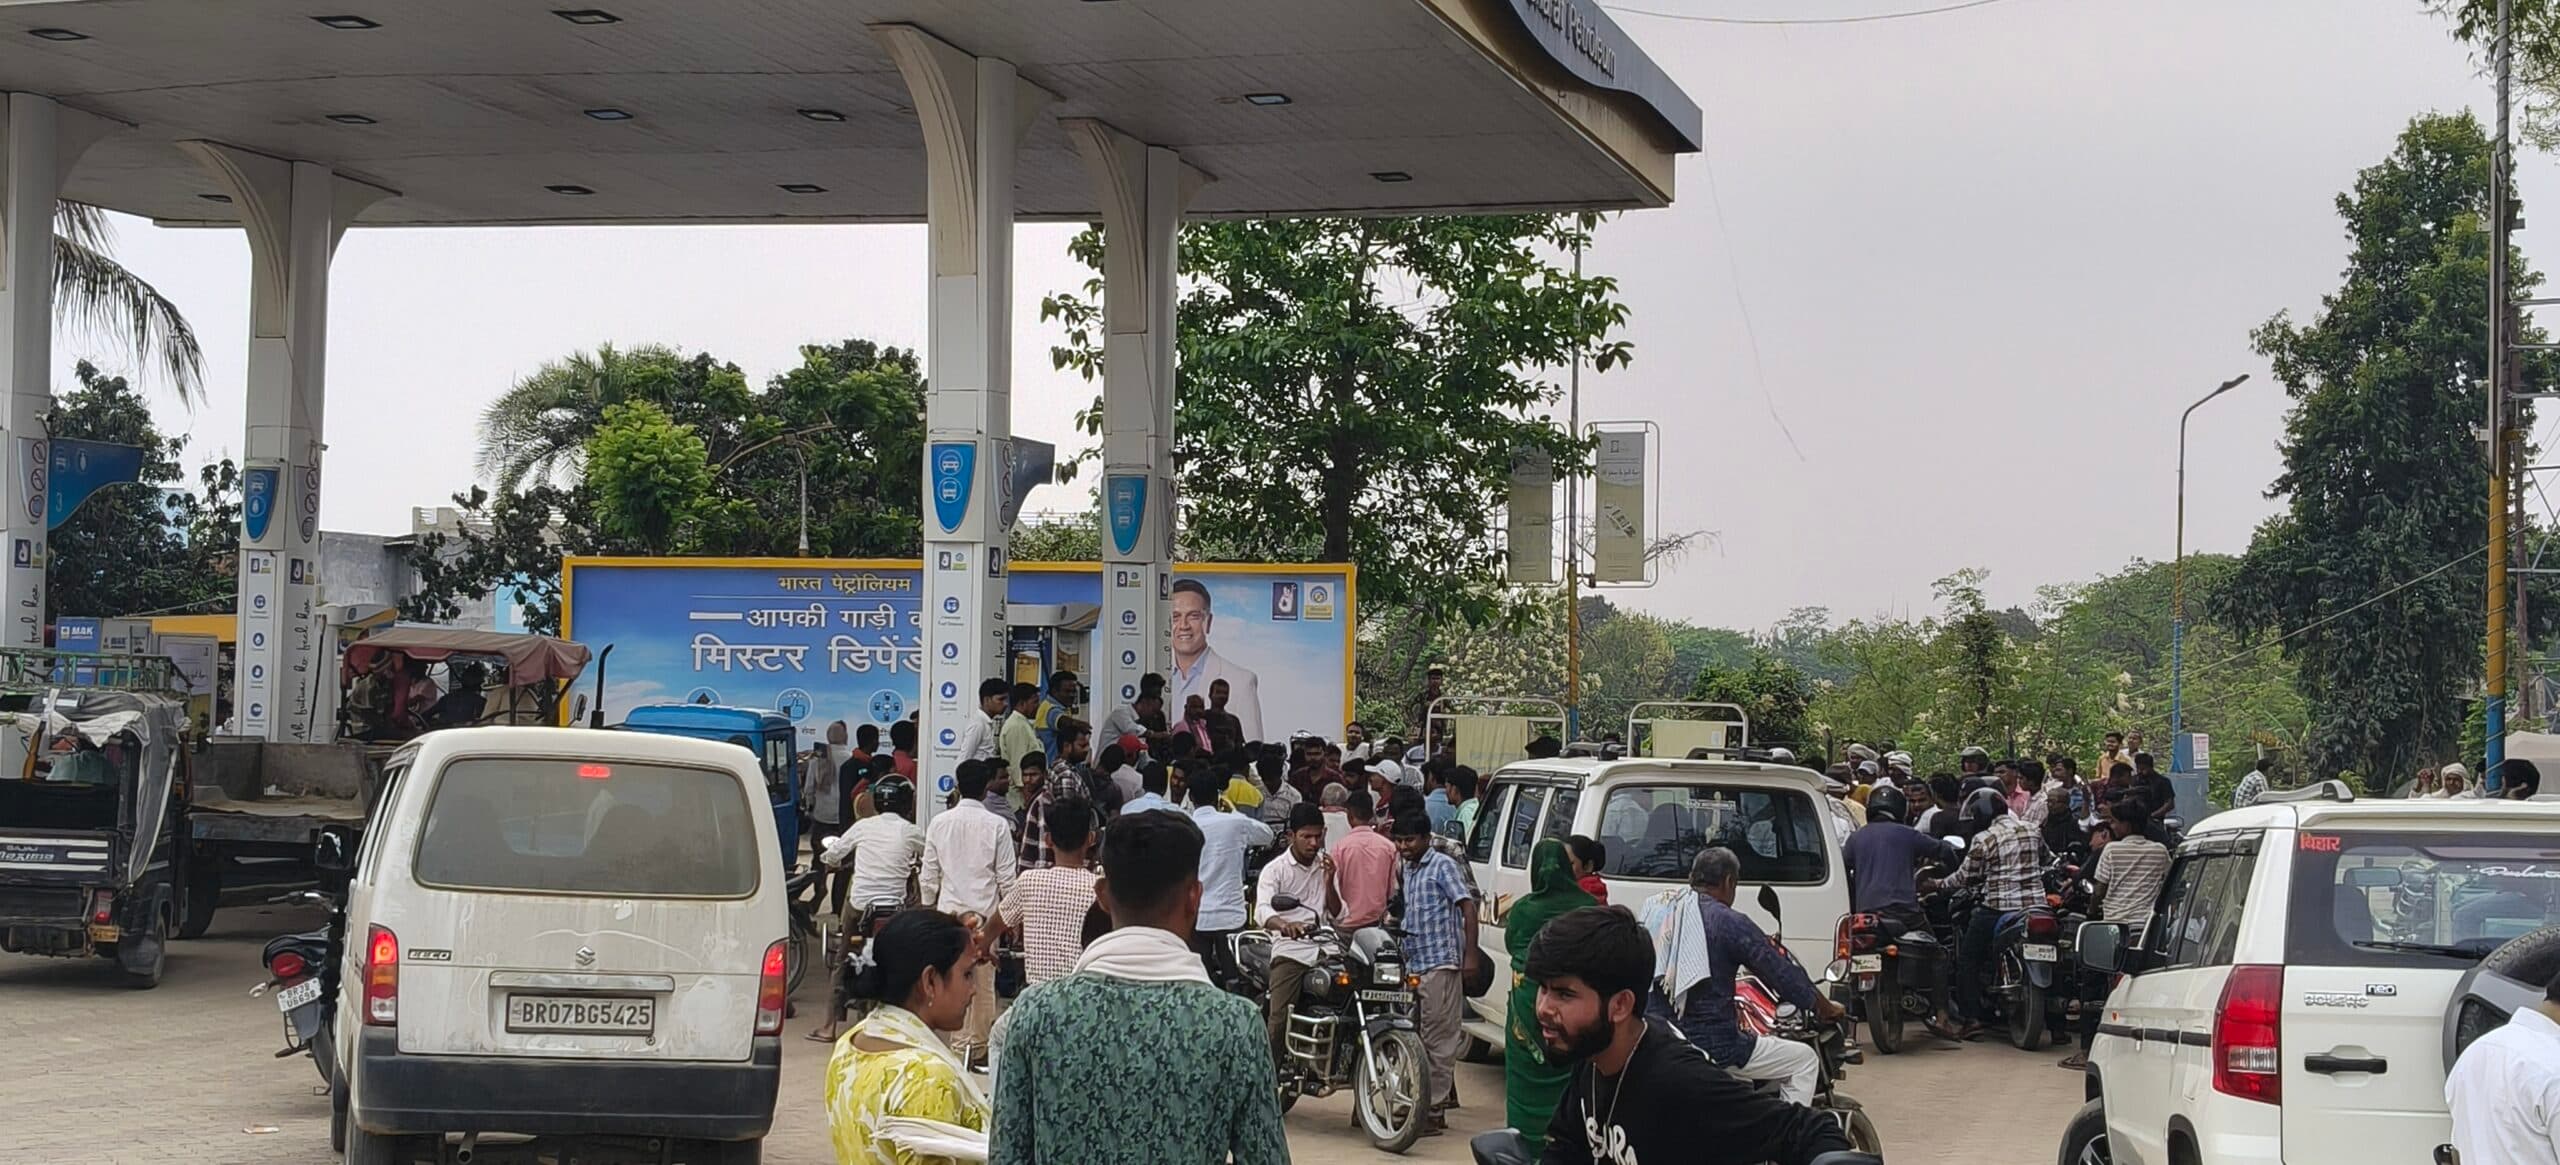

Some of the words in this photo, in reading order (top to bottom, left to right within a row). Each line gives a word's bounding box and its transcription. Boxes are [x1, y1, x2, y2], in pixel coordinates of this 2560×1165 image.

[1567, 2, 1617, 81] Petroleum
[778, 575, 822, 592] भारत
[831, 573, 911, 595] पेट्रोलियम
[746, 602, 827, 628] आपकी
[839, 602, 896, 630] गाड़ी
[71, 626, 94, 635] MAK
[691, 633, 809, 672] मिस्टर
[522, 1002, 651, 1025] BR07BG5425
